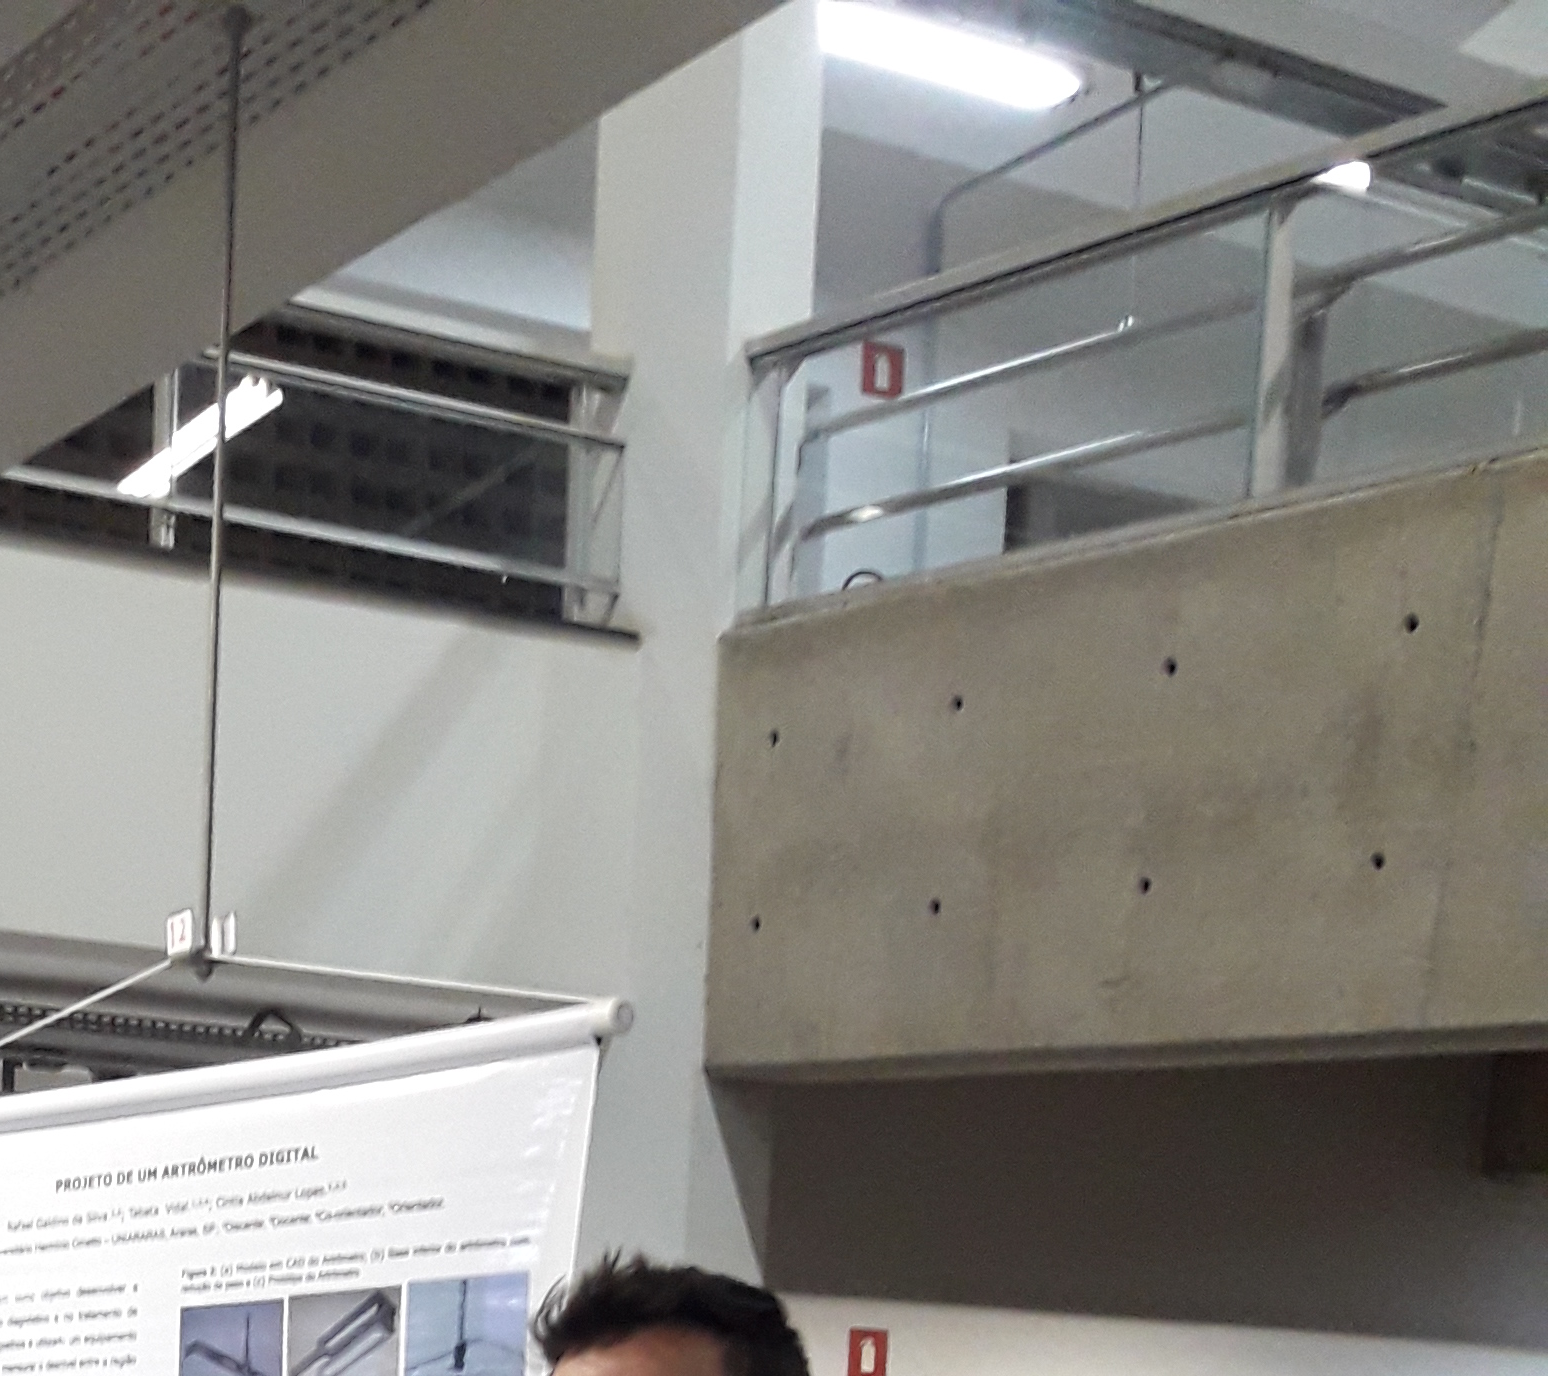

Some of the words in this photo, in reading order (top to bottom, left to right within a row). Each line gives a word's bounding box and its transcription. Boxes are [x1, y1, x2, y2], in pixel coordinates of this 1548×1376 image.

[55, 1171, 113, 1194] PROJETO
[116, 1169, 134, 1186] DE
[137, 1166, 158, 1184] UM
[161, 1152, 255, 1181] ARTRÔMETRO
[258, 1145, 319, 1168] DIGITAL
